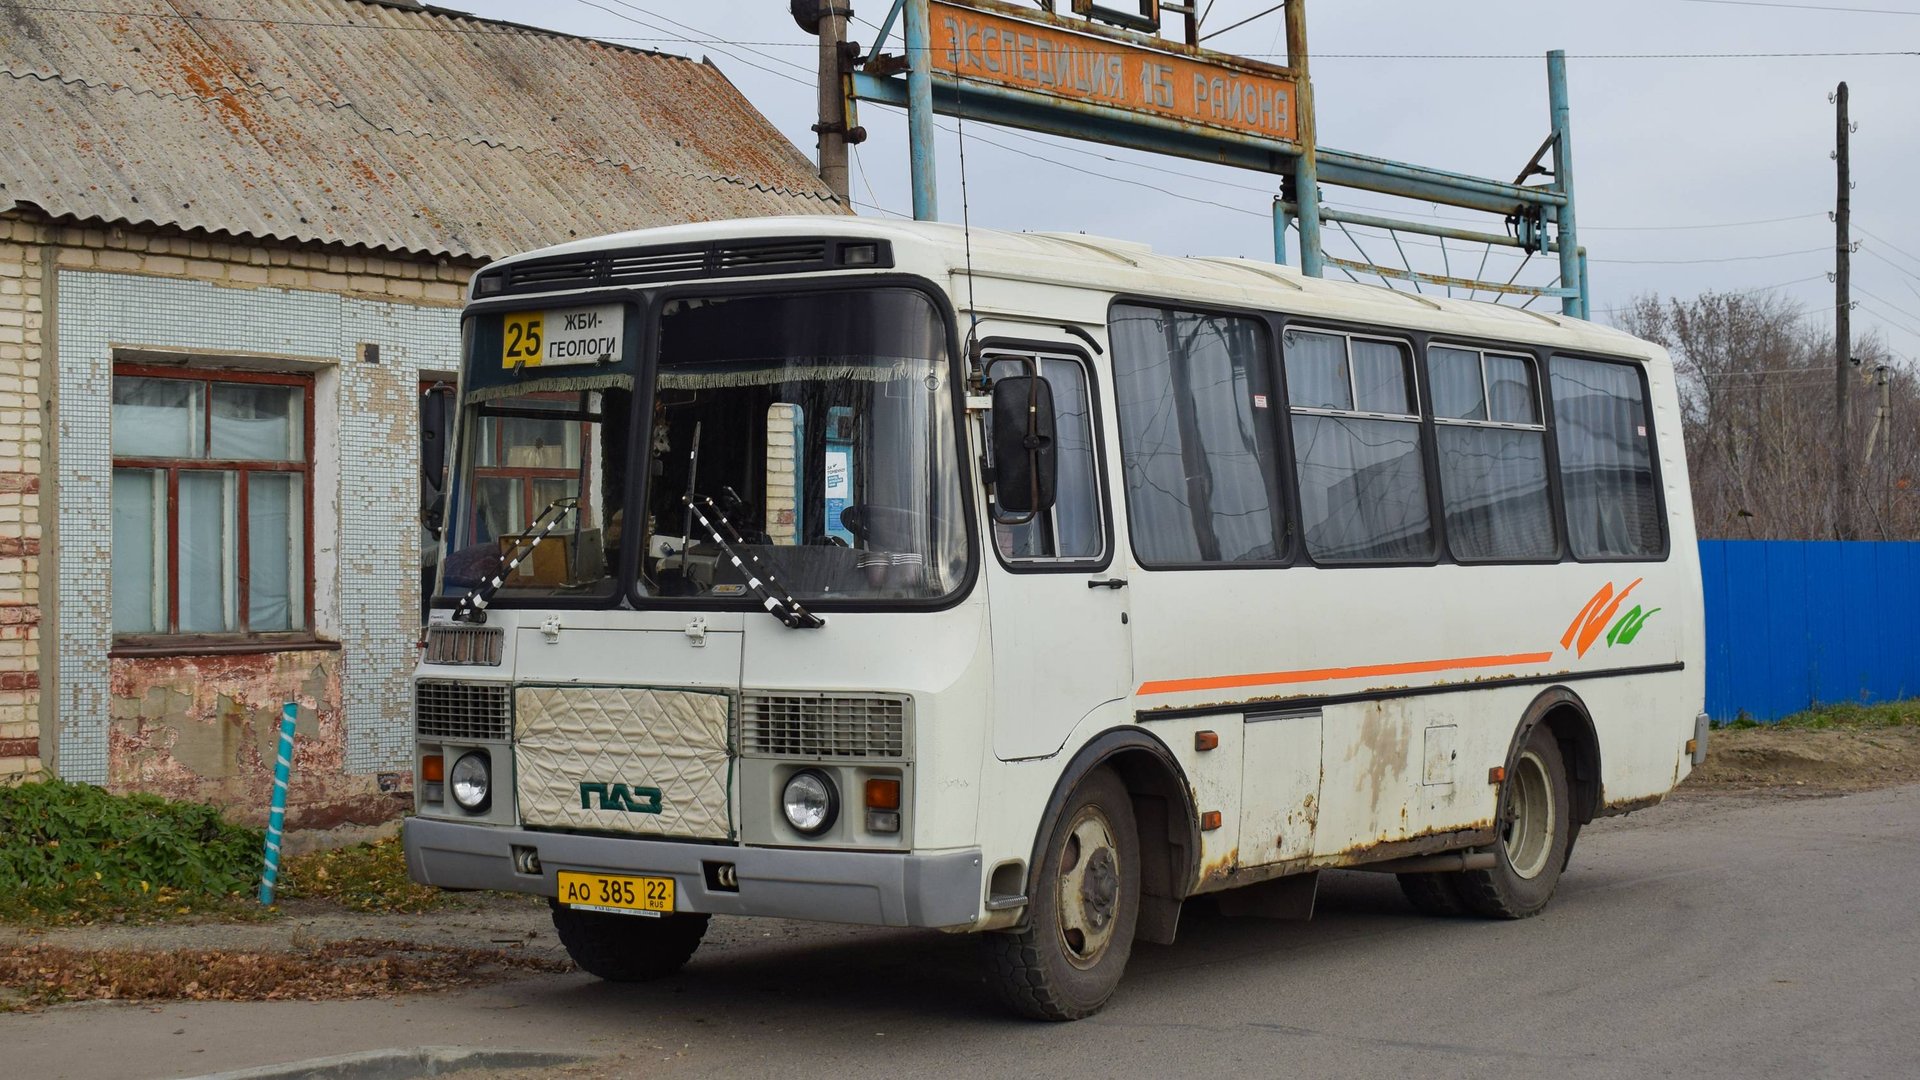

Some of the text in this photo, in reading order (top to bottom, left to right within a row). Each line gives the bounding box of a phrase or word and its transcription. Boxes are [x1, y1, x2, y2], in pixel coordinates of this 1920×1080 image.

[944, 16, 1289, 133] ЭКСПЕДИЦИЯ 15 РАЙОНА
[564, 312, 603, 331] ЖБИ-
[506, 320, 541, 358] 25
[549, 337, 616, 358] ГЕОЛОГИ
[579, 782, 663, 815] ПАЗ
[568, 879, 667, 904] АО 385 22
[650, 900, 664, 909] RUS
